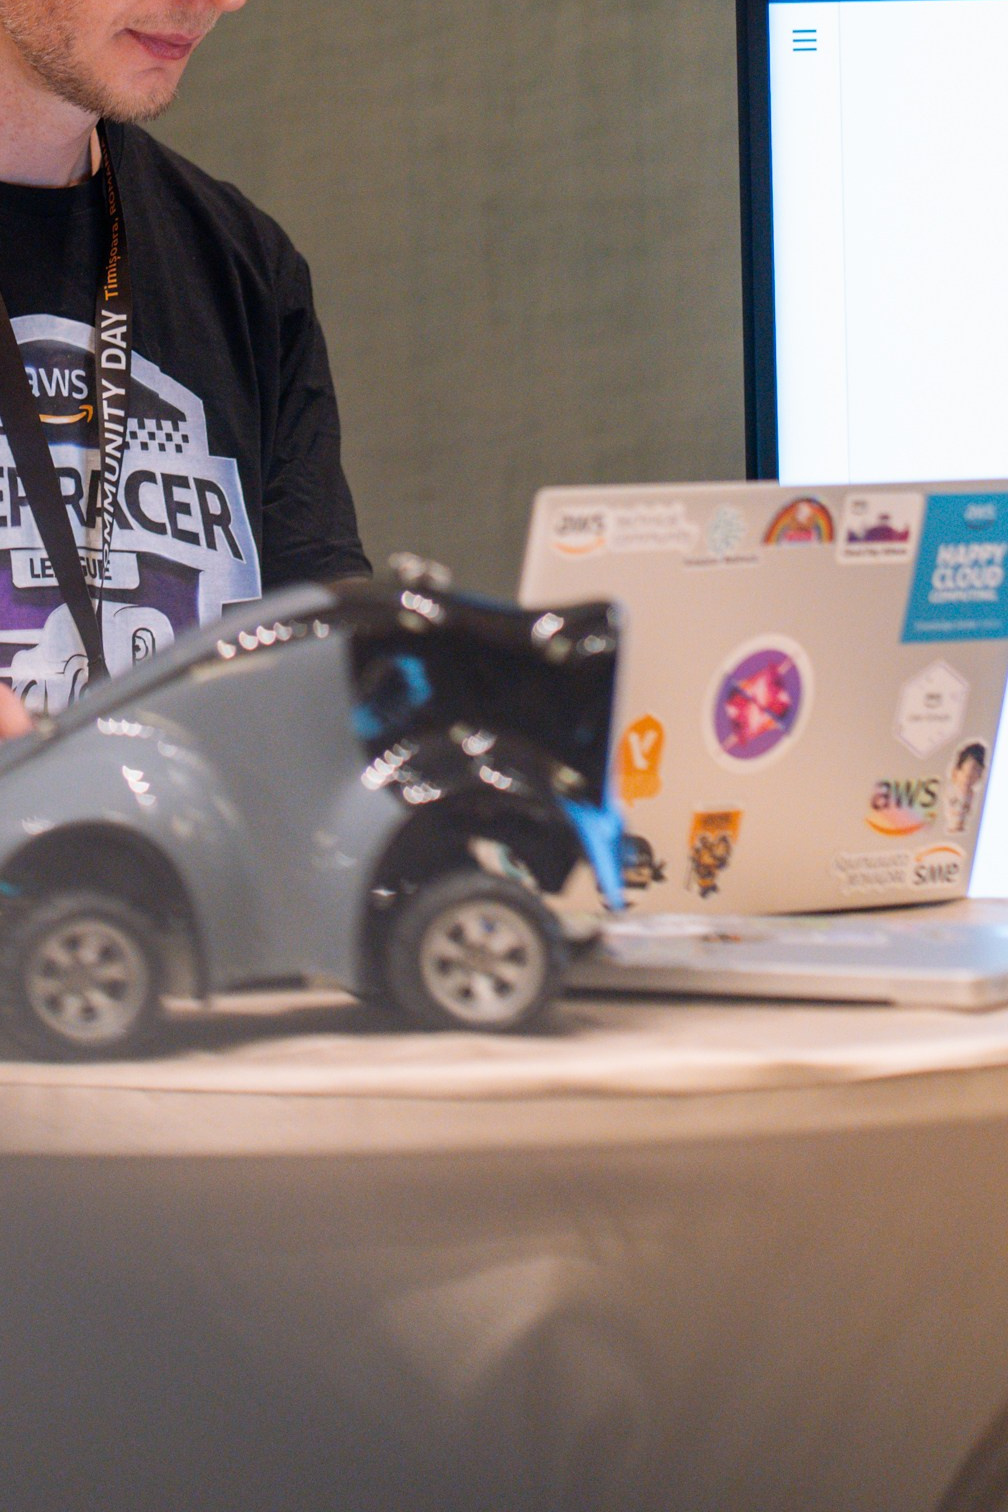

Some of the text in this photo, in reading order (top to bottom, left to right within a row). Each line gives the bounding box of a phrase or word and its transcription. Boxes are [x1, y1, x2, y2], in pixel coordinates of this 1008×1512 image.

[101, 309, 128, 371] DAY
[102, 378, 126, 569] OMMUNITY
[937, 543, 1008, 565] HAPPY
[932, 564, 1004, 589] CLOUD
[870, 778, 940, 811] aws
